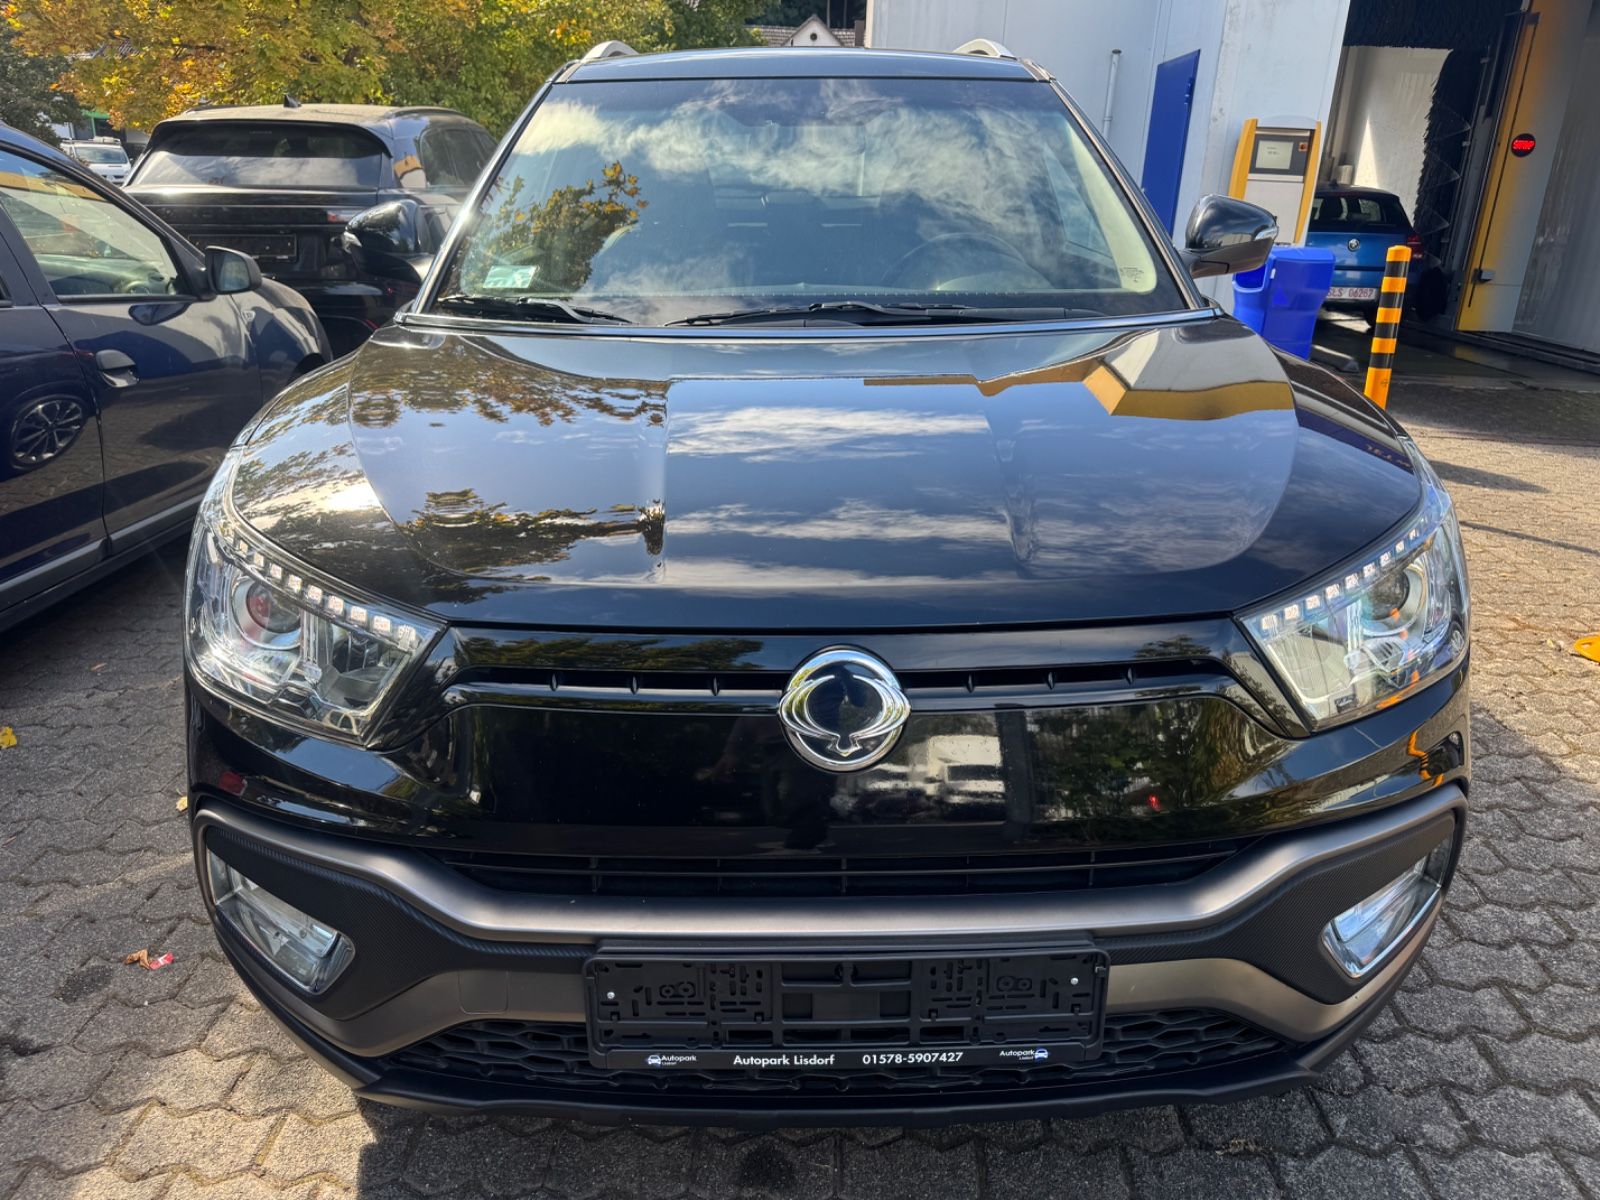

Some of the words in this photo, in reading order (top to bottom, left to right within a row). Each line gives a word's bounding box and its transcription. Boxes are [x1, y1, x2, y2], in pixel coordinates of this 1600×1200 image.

[661, 1054, 697, 1063] Autopark
[862, 1051, 964, 1065] 01578-5907427
[999, 1049, 1035, 1059] Autopark
[733, 1054, 790, 1068] Autopark
[793, 1053, 836, 1066] Lisdorf
